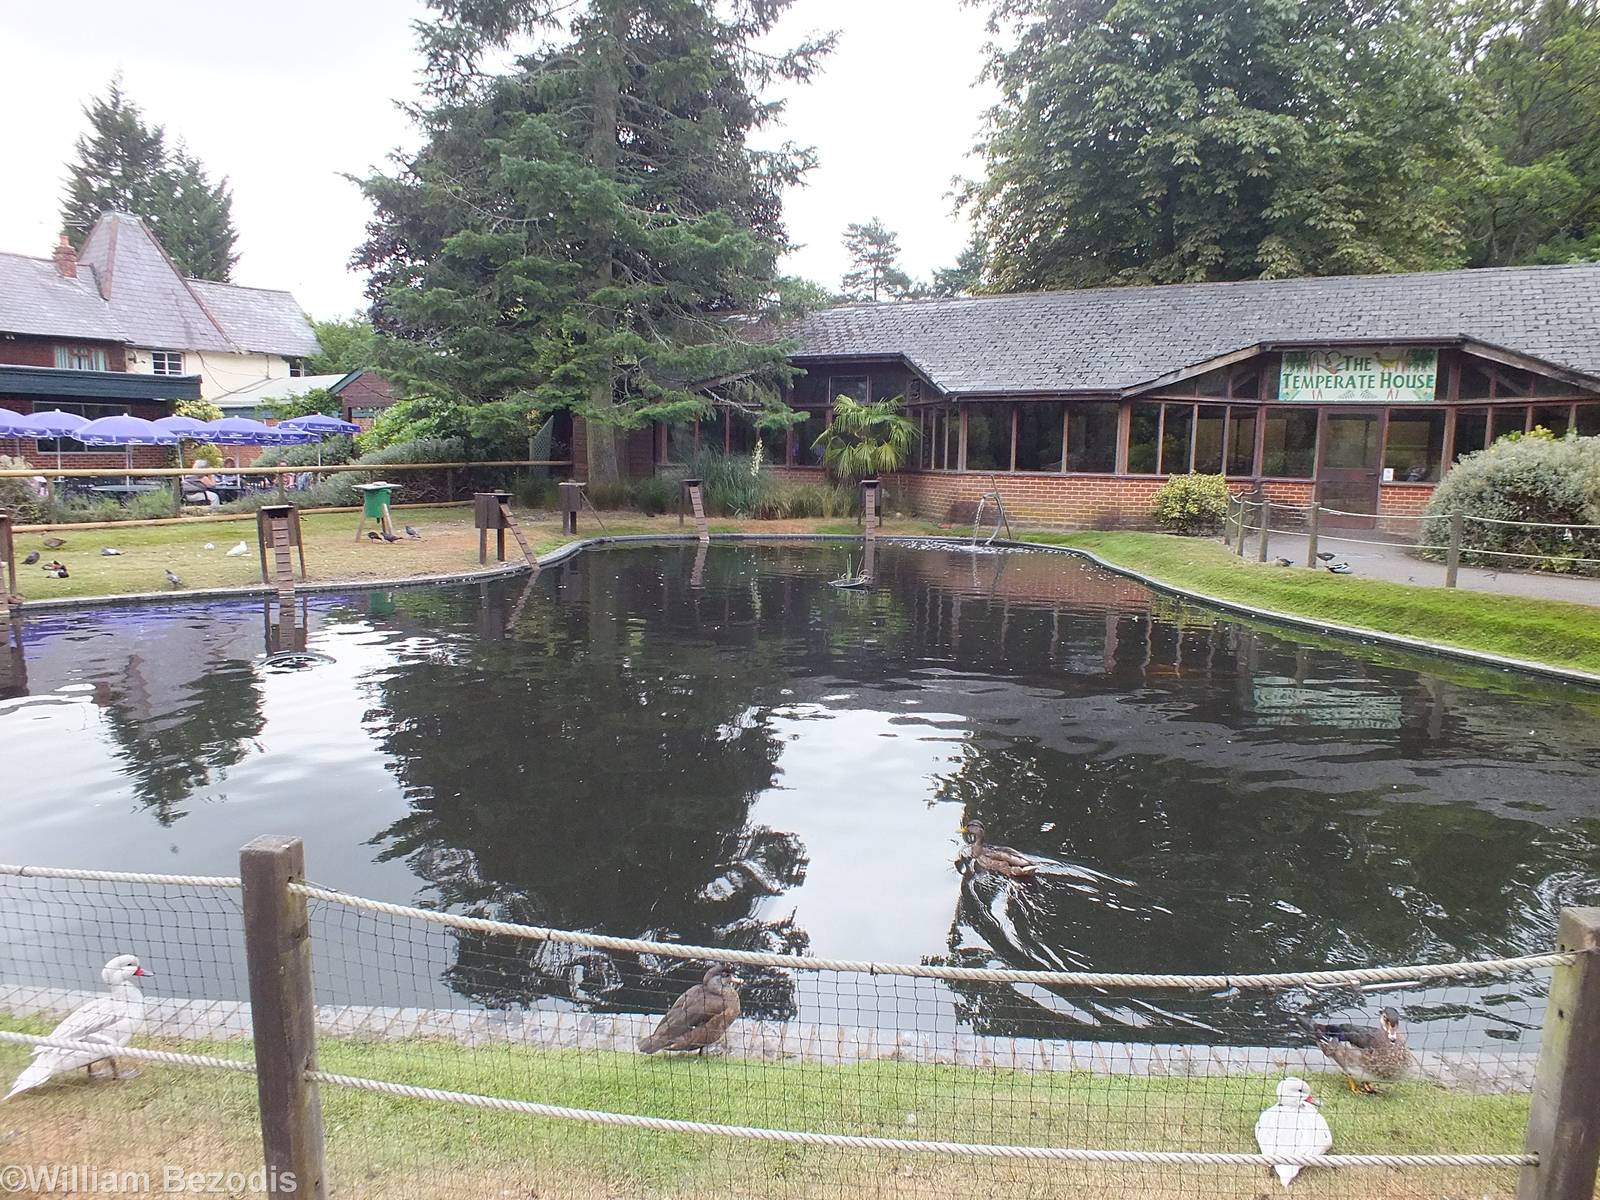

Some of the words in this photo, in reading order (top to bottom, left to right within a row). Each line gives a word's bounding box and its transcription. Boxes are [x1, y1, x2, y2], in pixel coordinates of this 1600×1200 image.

[1343, 355, 1372, 372] THE
[1283, 373, 1376, 389] TEMPERATE
[1380, 372, 1435, 389] HOUSE
